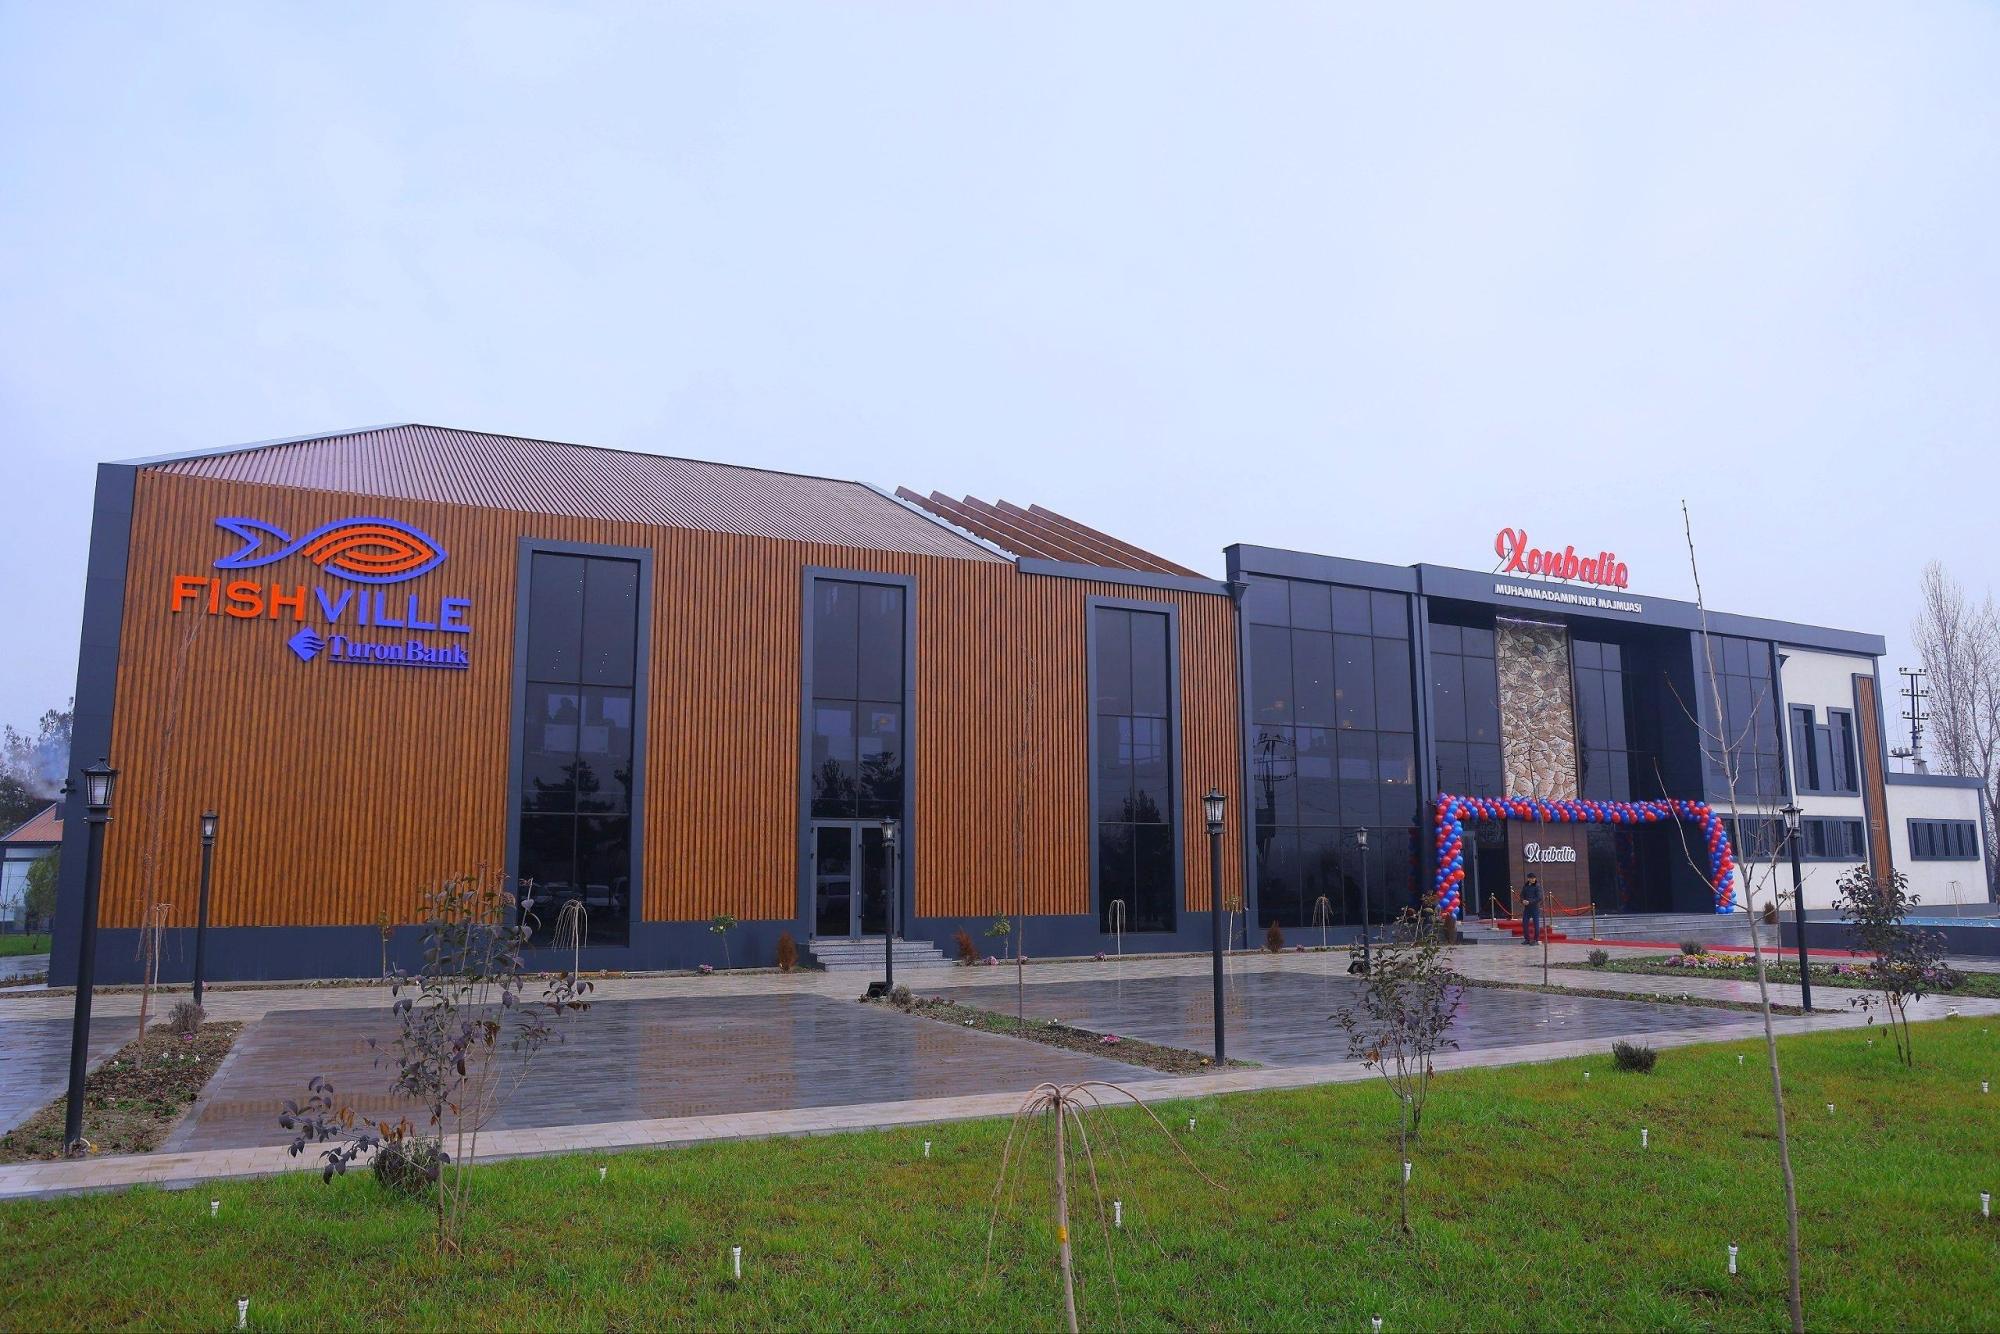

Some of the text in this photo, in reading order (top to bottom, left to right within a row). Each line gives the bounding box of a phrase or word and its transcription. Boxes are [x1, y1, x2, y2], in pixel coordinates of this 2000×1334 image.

[1495, 583, 1642, 613] MUHAMMADAMIN NUR MAJMUASI
[328, 635, 469, 663] TuronBank
